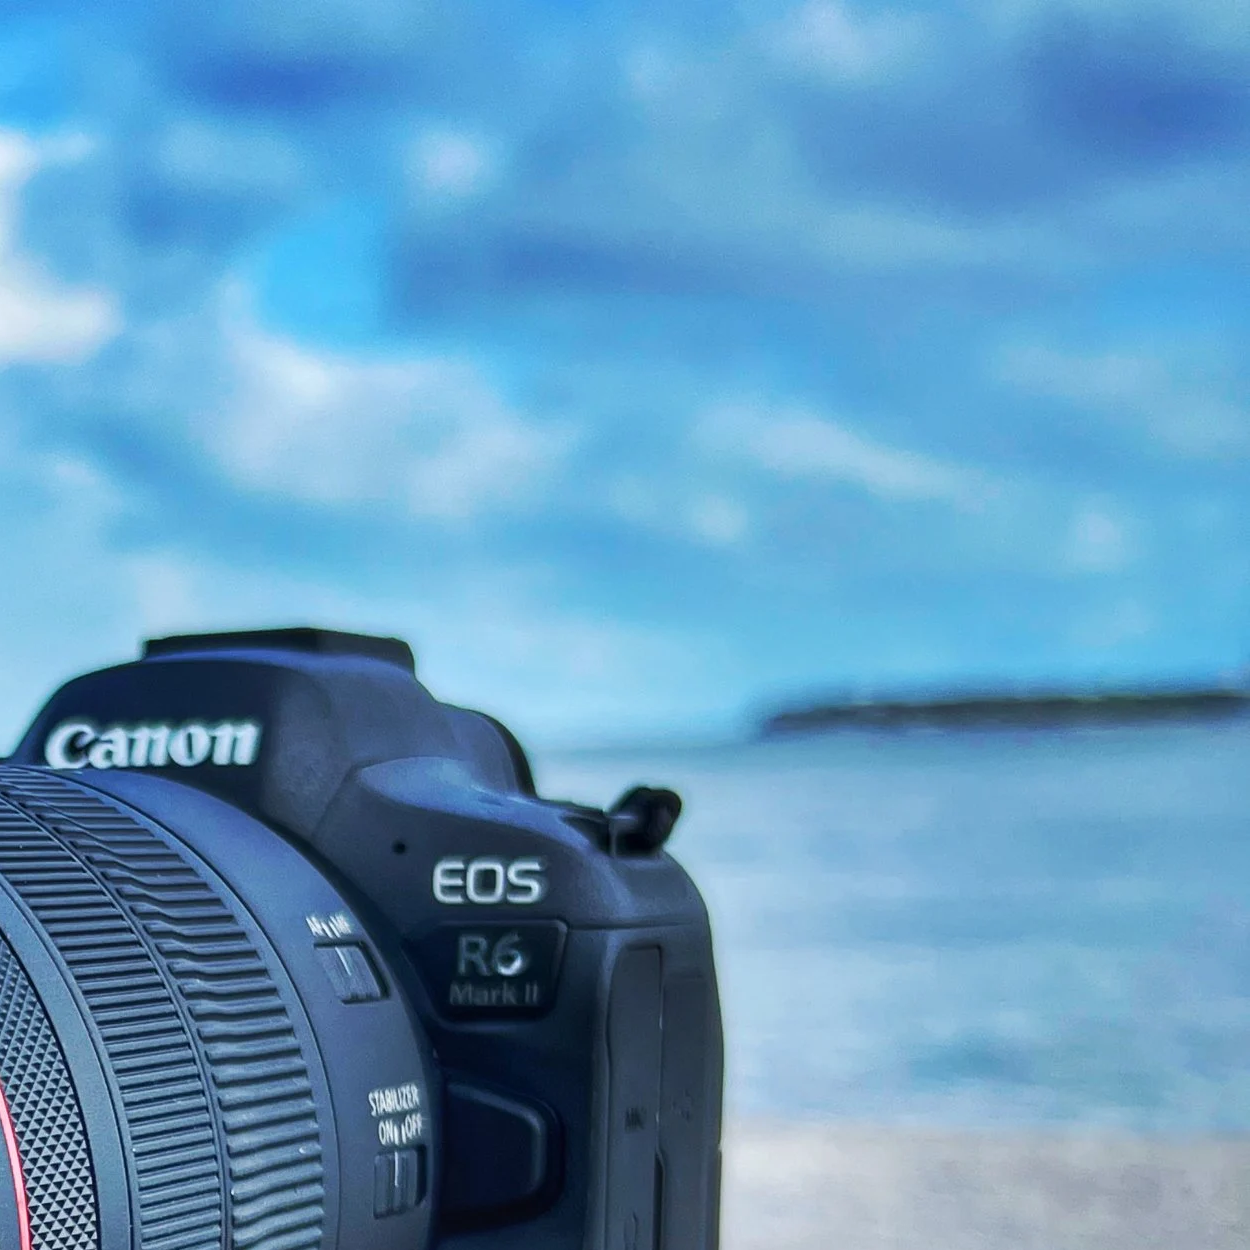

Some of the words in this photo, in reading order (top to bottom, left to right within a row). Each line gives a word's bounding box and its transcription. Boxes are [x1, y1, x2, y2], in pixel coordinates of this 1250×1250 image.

[45, 723, 261, 769] Canon
[433, 859, 542, 904] EOS
[458, 932, 526, 976] R6
[450, 981, 517, 1005] Mark
[368, 1083, 420, 1117] STABILIZER
[378, 1120, 394, 1146] ON
[405, 1113, 423, 1140] OFF
